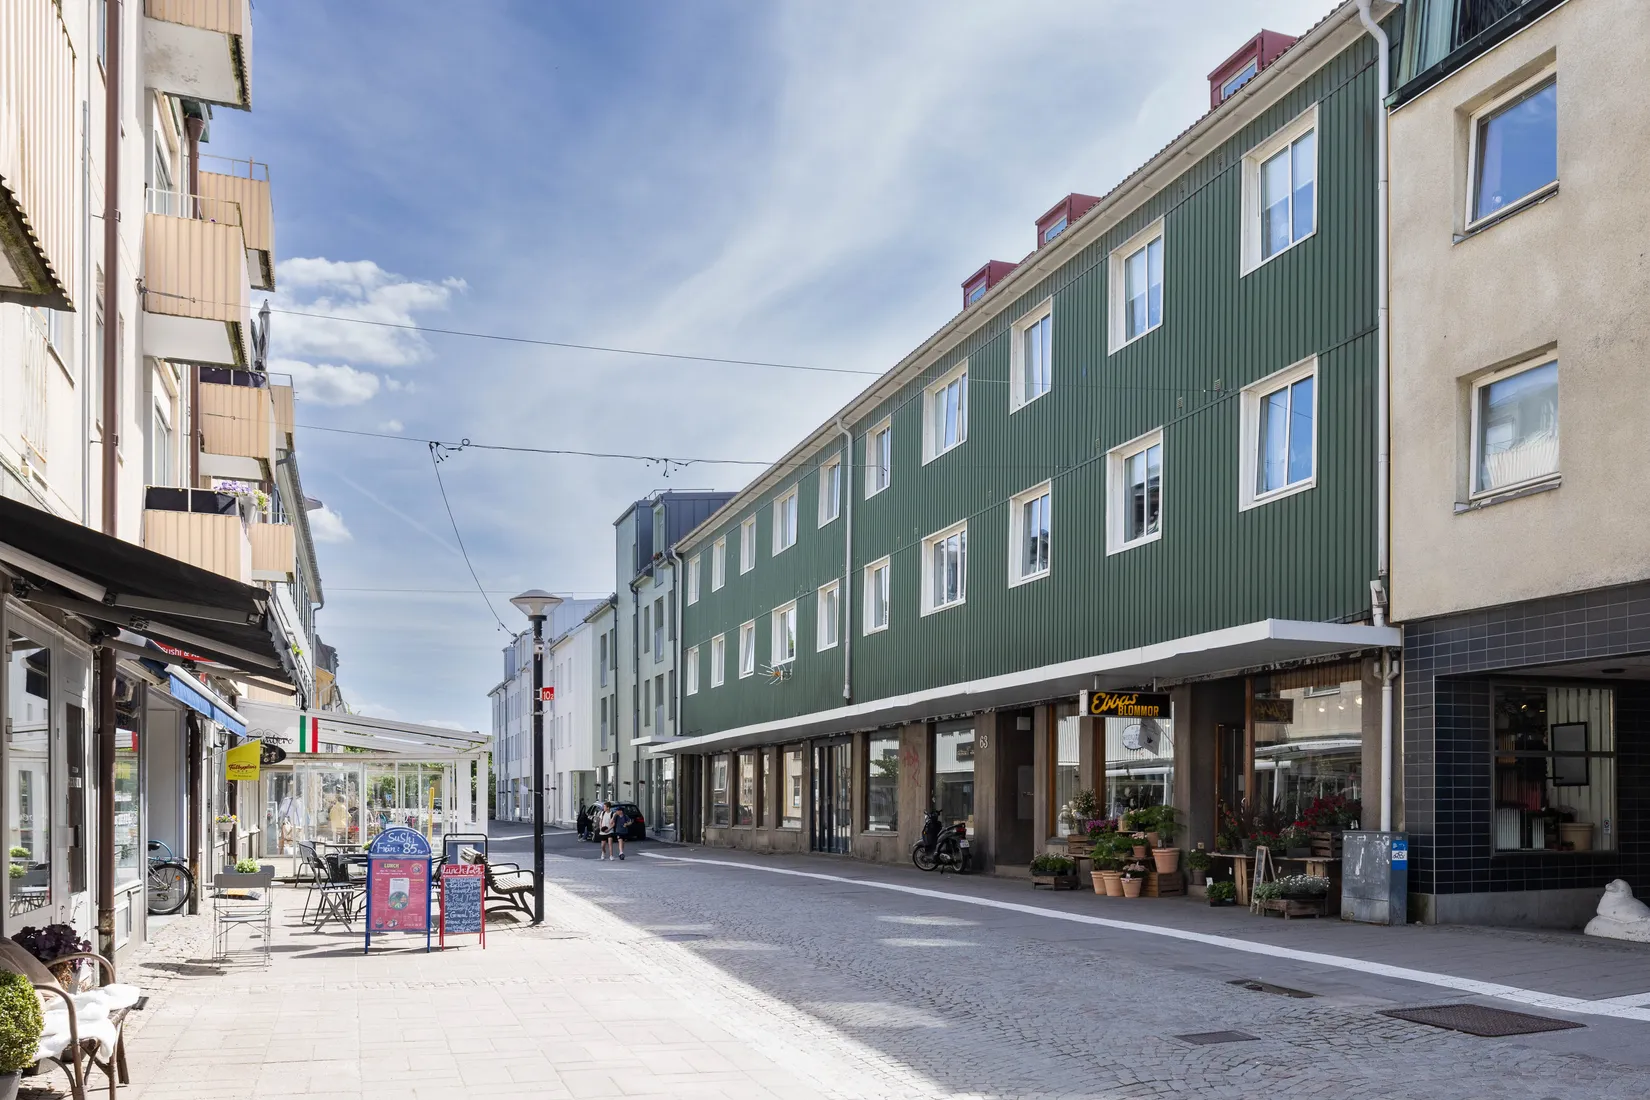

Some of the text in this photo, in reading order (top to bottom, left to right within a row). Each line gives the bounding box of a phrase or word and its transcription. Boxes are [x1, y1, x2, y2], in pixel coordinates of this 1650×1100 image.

[1090, 691, 1139, 714] Ebbas
[1118, 704, 1159, 716] BLOMMOR
[979, 735, 988, 749] 63
[402, 842, 418, 854] 85
